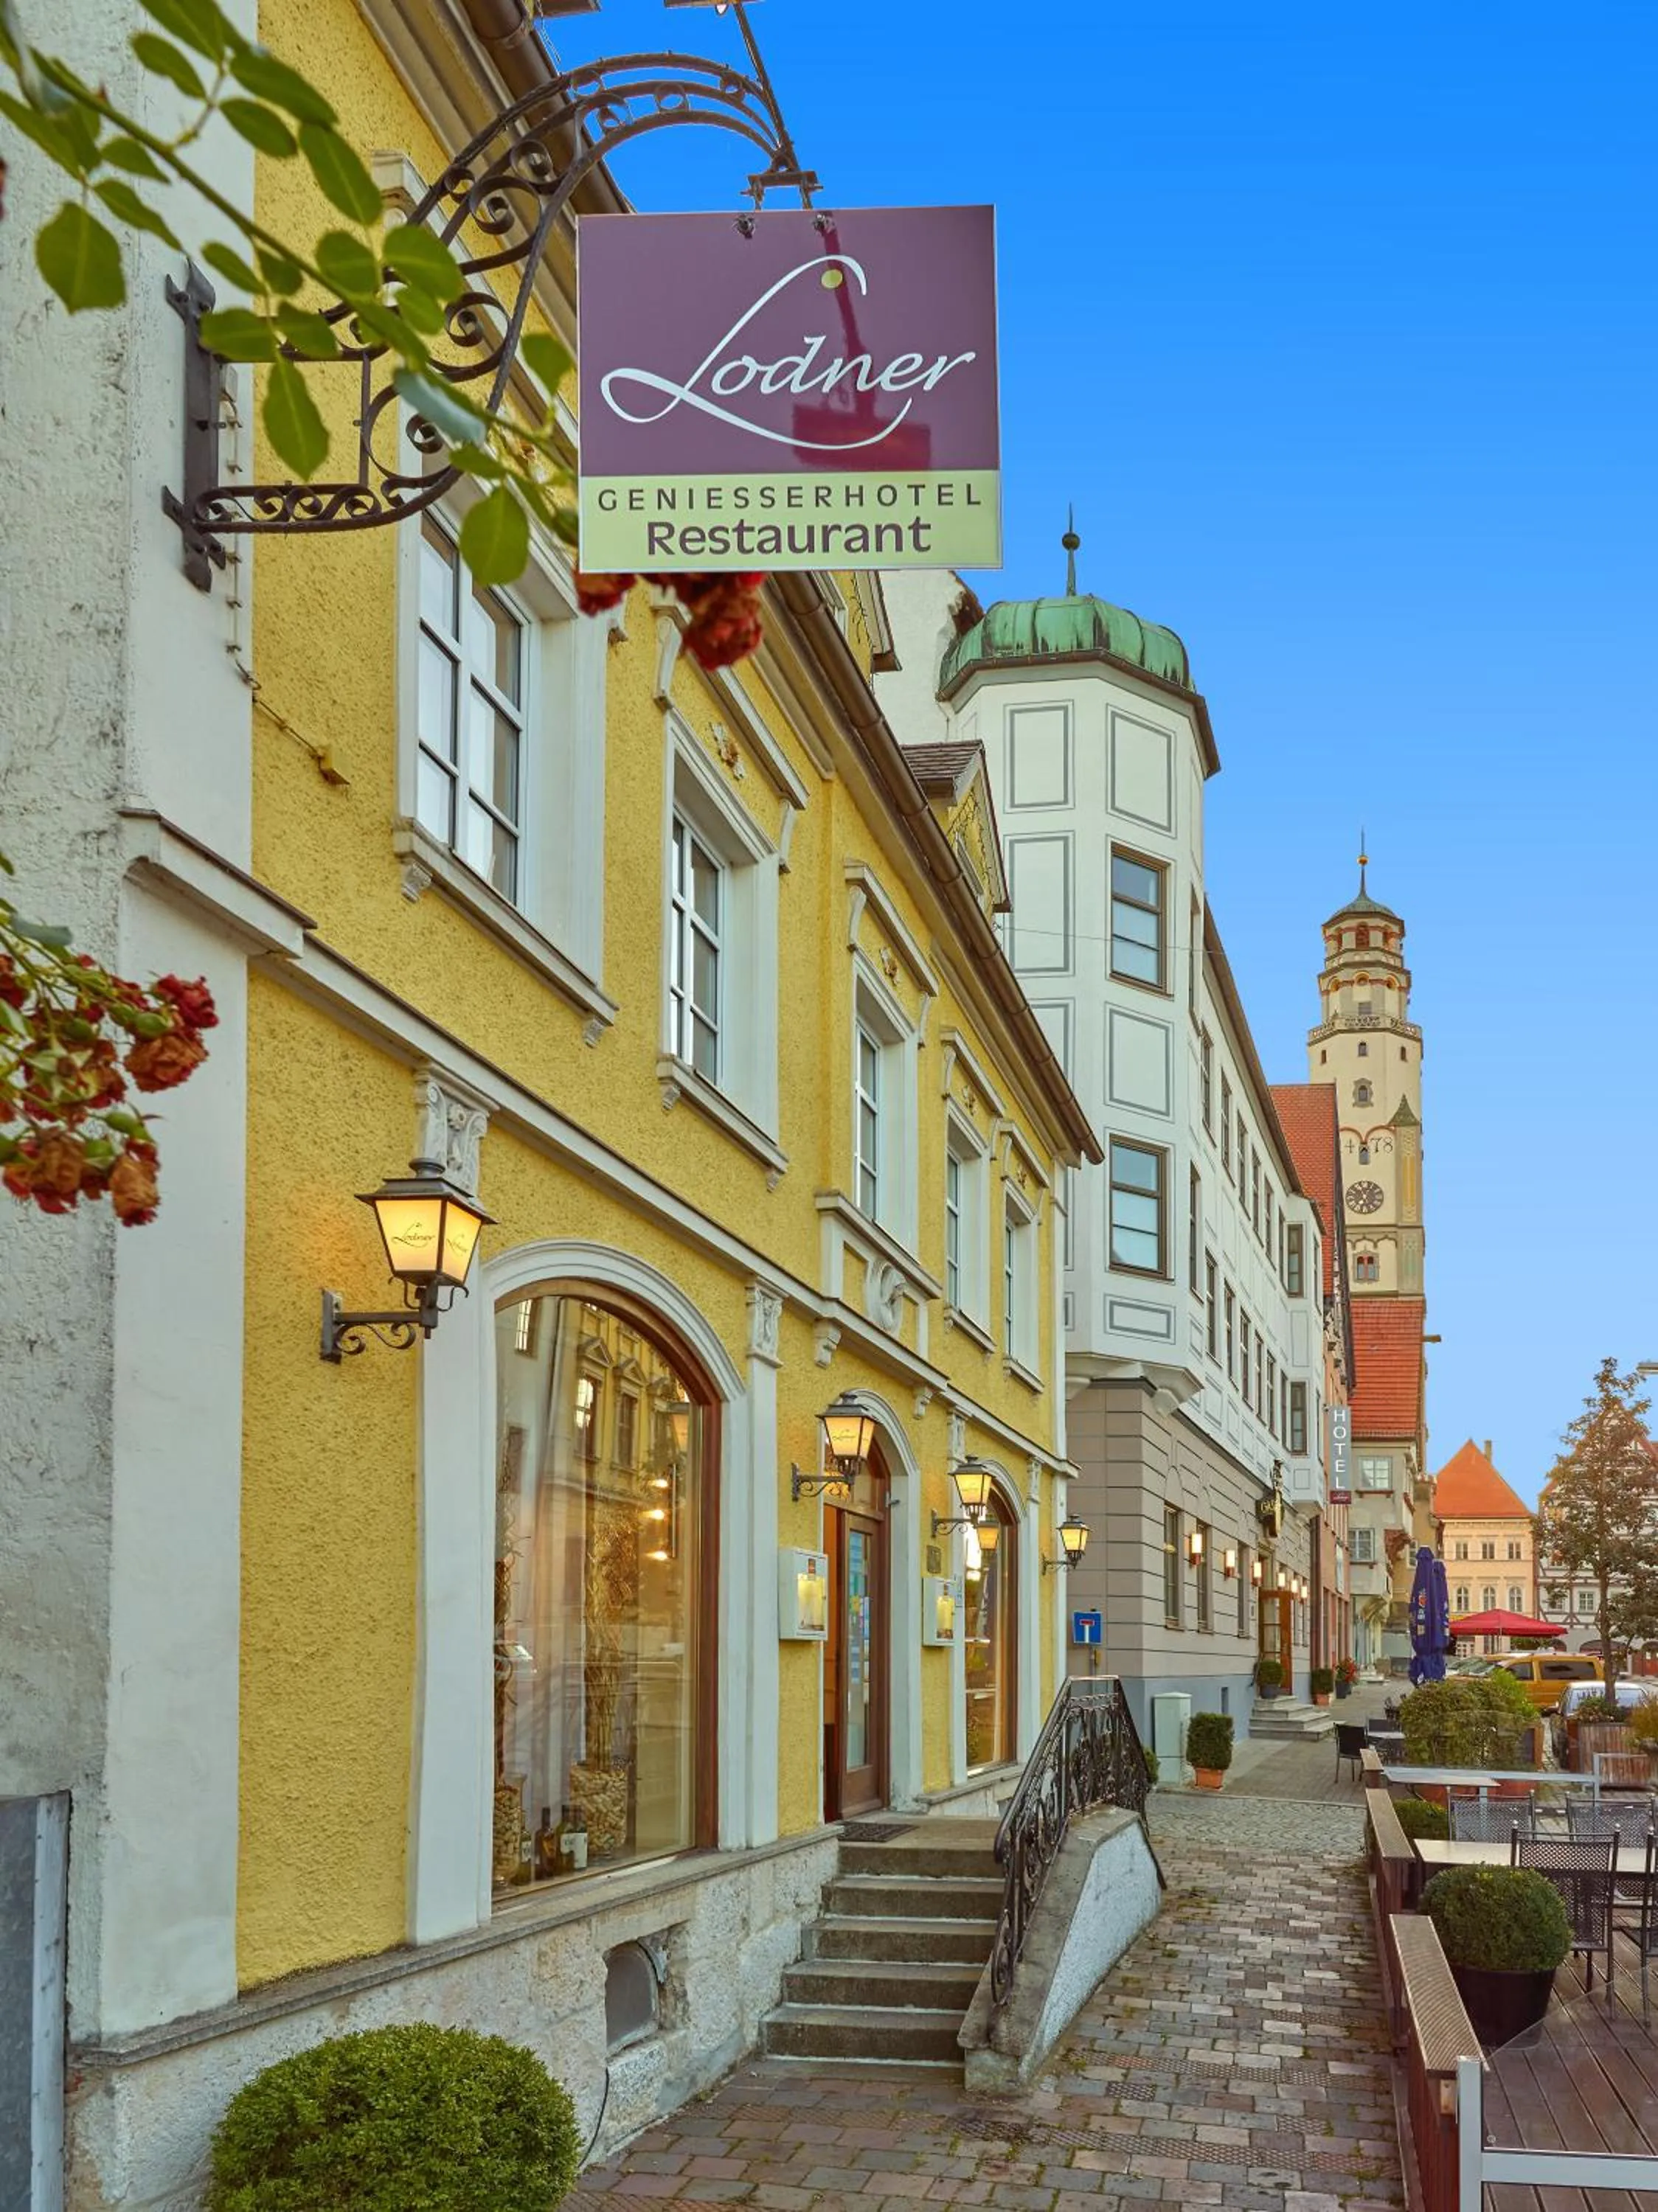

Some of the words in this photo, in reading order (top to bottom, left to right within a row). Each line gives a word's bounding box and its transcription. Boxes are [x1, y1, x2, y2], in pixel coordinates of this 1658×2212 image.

[600, 254, 977, 450] Lodner
[598, 484, 981, 510] GENIESSERHOTEL
[648, 516, 932, 555] Restaurant
[1333, 1410, 1346, 1489] HOTEL
